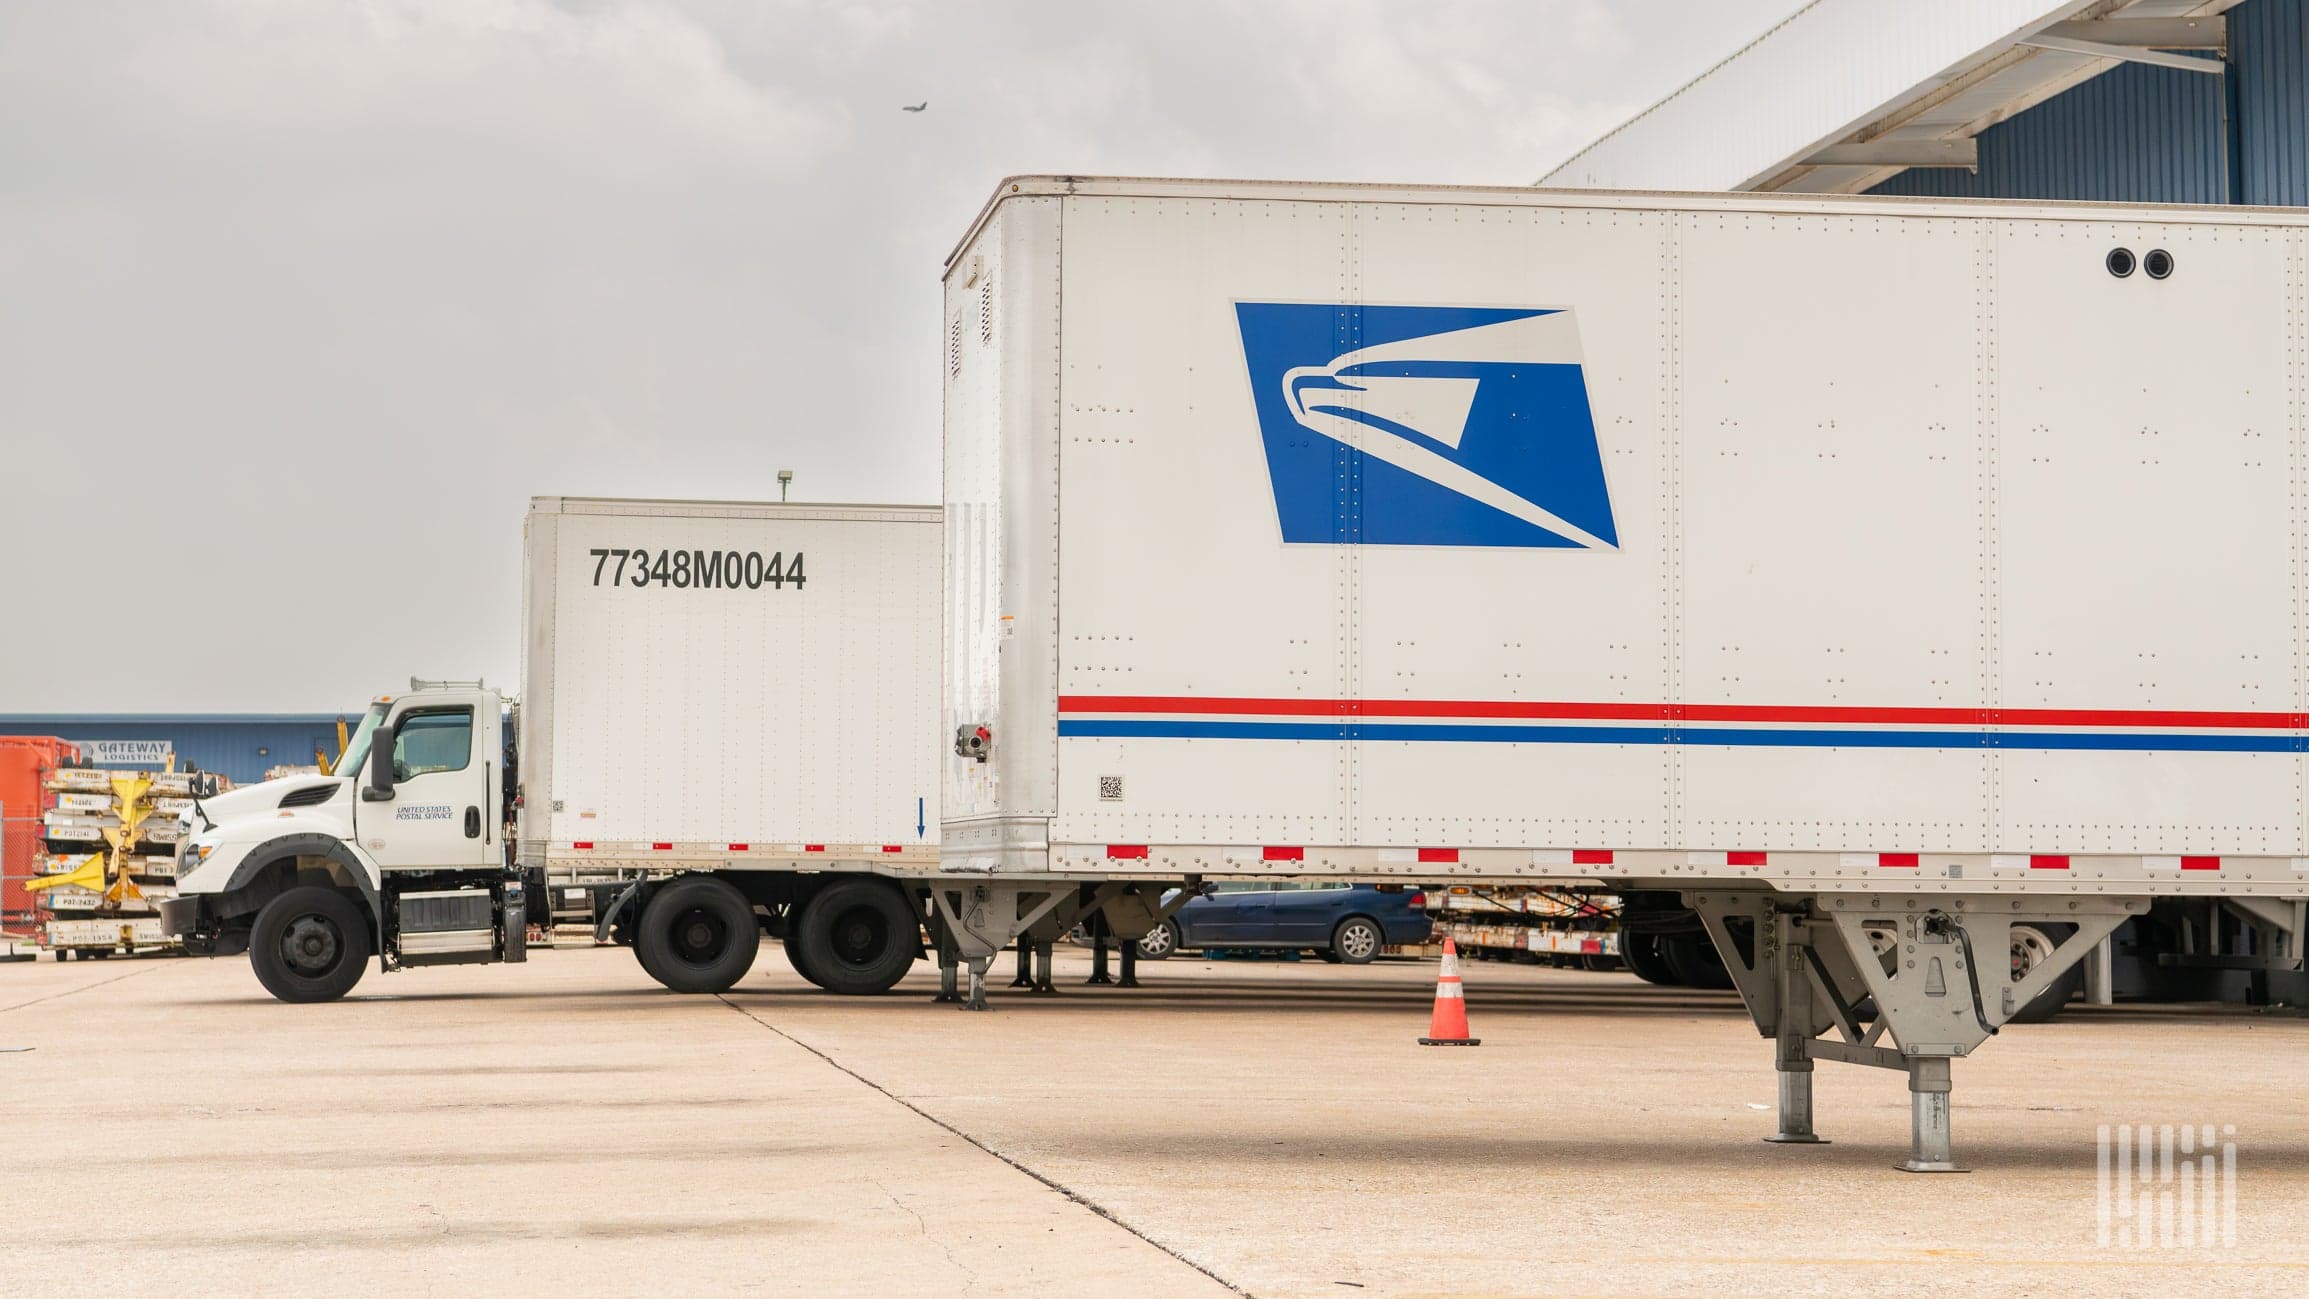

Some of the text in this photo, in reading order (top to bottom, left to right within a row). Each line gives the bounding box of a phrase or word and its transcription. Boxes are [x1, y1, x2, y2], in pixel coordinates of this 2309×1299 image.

[590, 548, 806, 590] 77348M0044
[98, 743, 166, 753] GATEWAY
[104, 753, 158, 761] LOGISTICS
